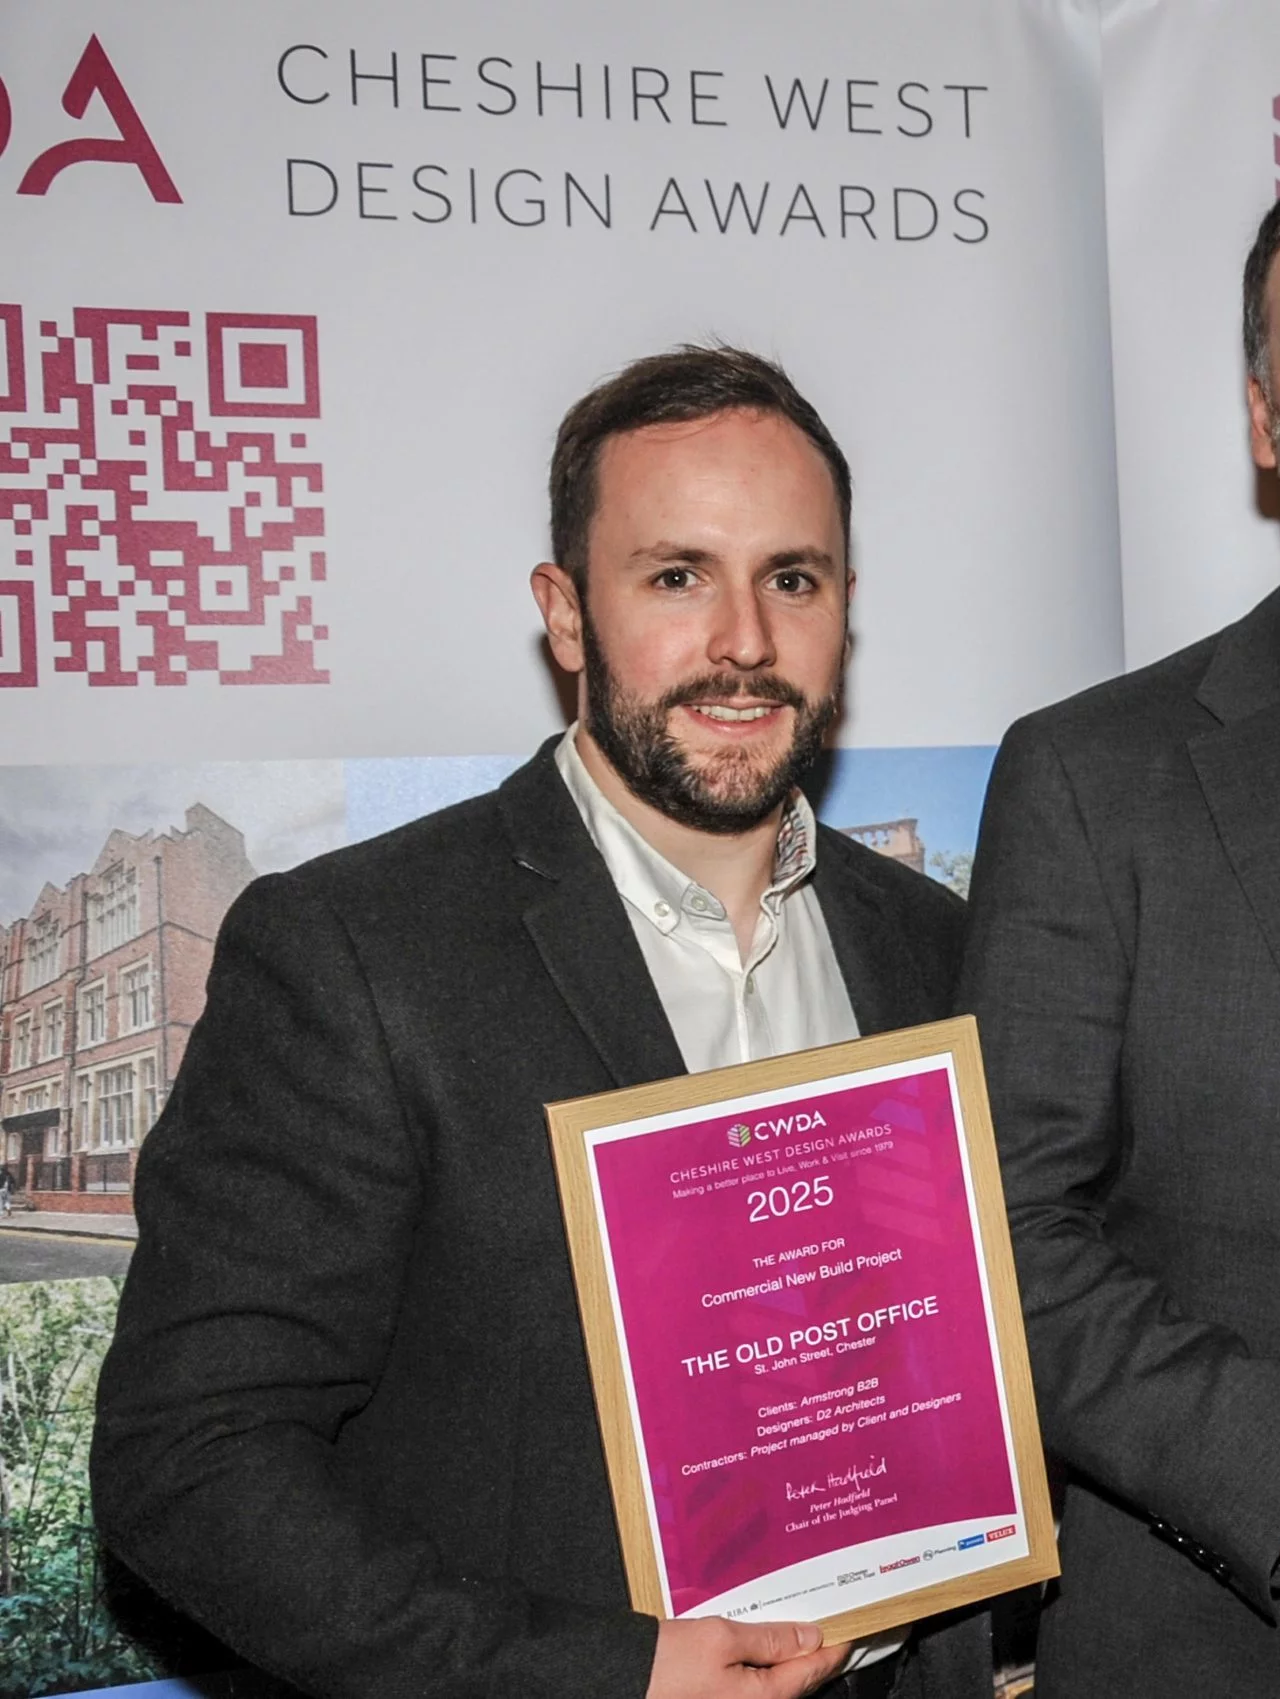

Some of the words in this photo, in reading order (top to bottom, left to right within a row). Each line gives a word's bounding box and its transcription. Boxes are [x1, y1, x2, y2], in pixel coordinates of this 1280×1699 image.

[277, 44, 729, 127] CHESHIRE
[765, 74, 989, 139] WEST
[0, 33, 184, 204] A
[286, 158, 614, 230] DESIGN
[650, 178, 990, 244] AWARDS
[754, 1110, 826, 1140] CWDA
[670, 1159, 739, 1183] CHESHIRE
[743, 1149, 780, 1166] WEST
[785, 1137, 835, 1158] DESIGN
[838, 1124, 892, 1145] AWARDS
[672, 1185, 705, 1199] Making
[714, 1178, 739, 1190] better
[741, 1172, 765, 1184] place
[766, 1169, 775, 1178] to
[798, 1160, 820, 1170] Work
[822, 1156, 829, 1165] &
[831, 1151, 849, 1162] Visit
[850, 1147, 872, 1159] since
[874, 1140, 894, 1153] 1979
[747, 1175, 834, 1223] 2025
[701, 1276, 783, 1308] Commercial
[786, 1270, 817, 1287] New
[819, 1259, 854, 1279] Build
[856, 1248, 902, 1270] Project
[752, 1254, 776, 1269] THE
[778, 1244, 819, 1263] AWARD
[822, 1237, 846, 1252] FOR
[681, 1348, 731, 1377] THE
[736, 1336, 783, 1364] OLD
[789, 1317, 852, 1350] POST
[857, 1295, 939, 1332] OFFICE
[755, 1363, 769, 1375] St.
[771, 1356, 798, 1371] John
[836, 1335, 877, 1354] Chester
[756, 1415, 813, 1437] Designers:
[816, 1408, 832, 1422] D2
[834, 1395, 886, 1415] Architects
[757, 1401, 798, 1418] Clients:
[800, 1385, 855, 1407] Armstrong
[857, 1377, 879, 1392] B2B
[681, 1451, 748, 1476] Contractors:
[750, 1439, 788, 1457] Project
[789, 1425, 839, 1447] managed
[841, 1421, 855, 1433] by
[857, 1413, 887, 1428] Client
[889, 1405, 909, 1419] and
[911, 1392, 962, 1414] Designers
[785, 1520, 810, 1533] Chair
[811, 1515, 821, 1526] of
[822, 1512, 838, 1522] the
[839, 1503, 873, 1519] Judging
[874, 1492, 898, 1507] Panel
[809, 1500, 832, 1513] Peter
[833, 1487, 871, 1507] Hadfield
